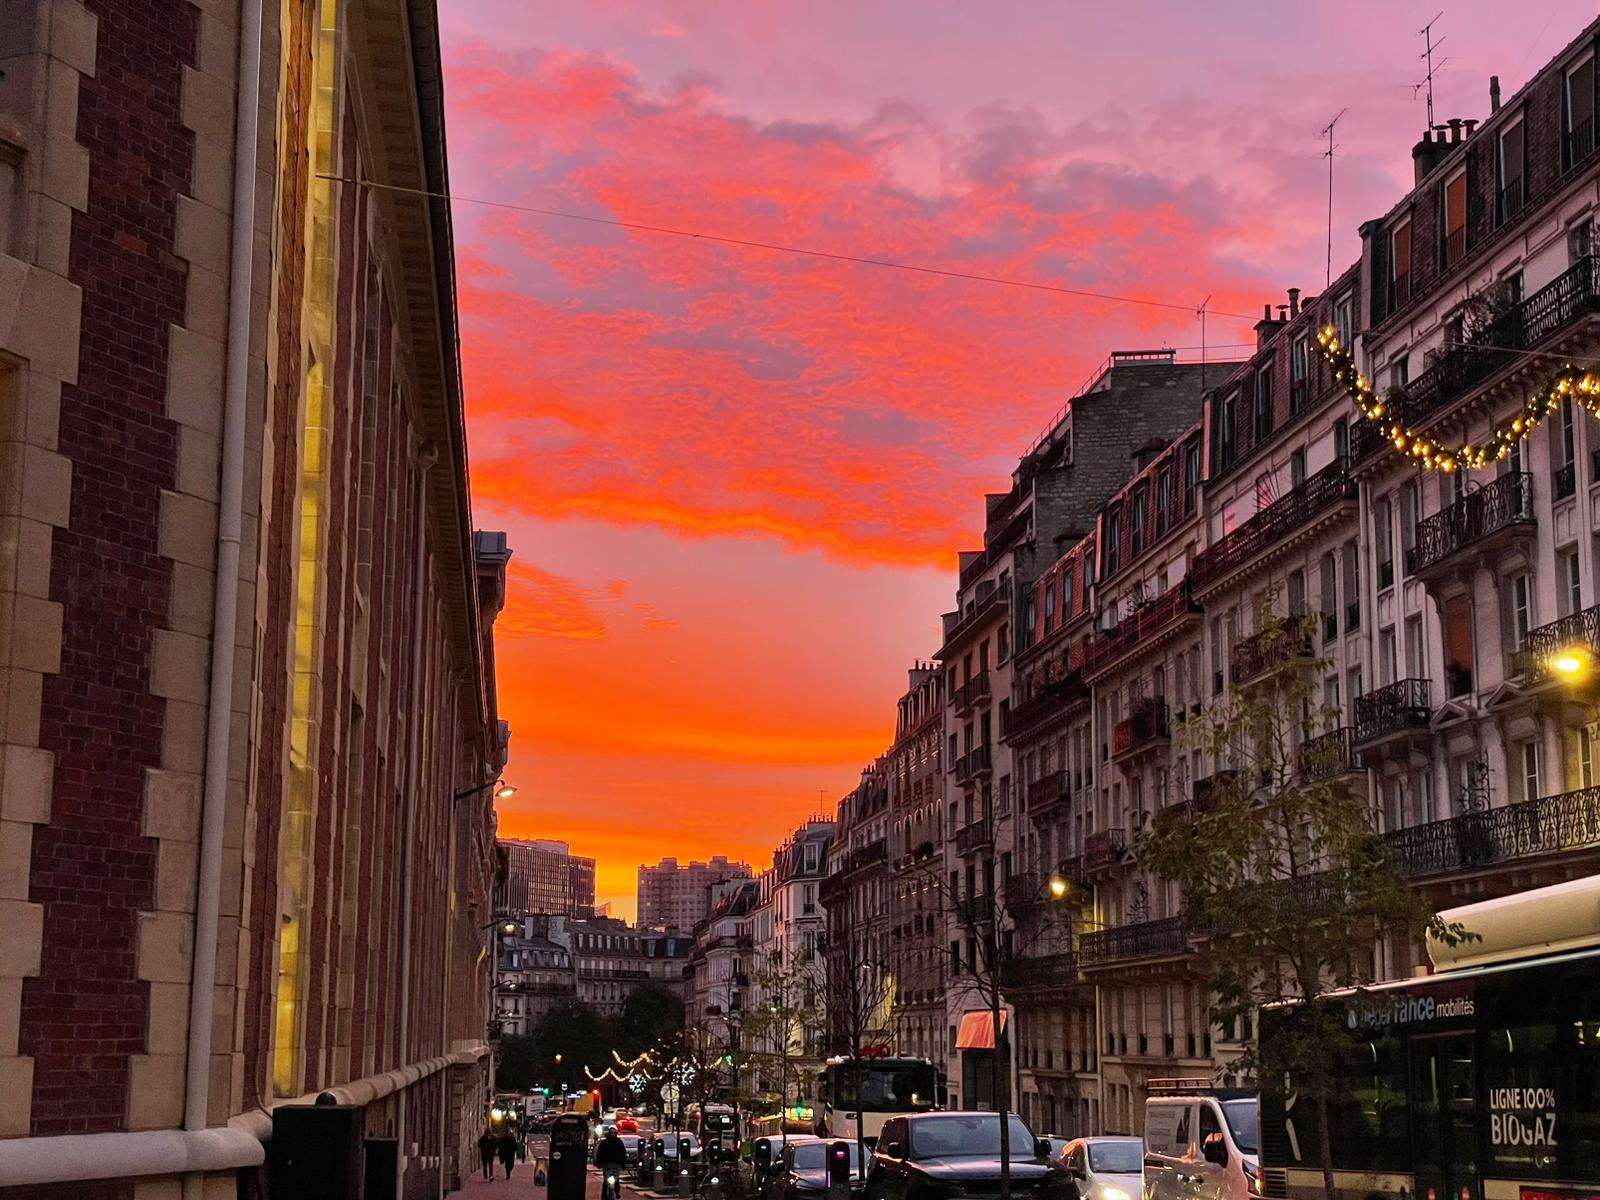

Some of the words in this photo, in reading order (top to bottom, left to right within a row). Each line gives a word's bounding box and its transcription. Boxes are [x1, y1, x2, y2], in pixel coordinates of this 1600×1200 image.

[1436, 995, 1475, 1018] mobilités
[1490, 1088, 1521, 1109] LIGNE
[1523, 1087, 1556, 1109] 100%
[1491, 1111, 1559, 1146] BIOGAZ
